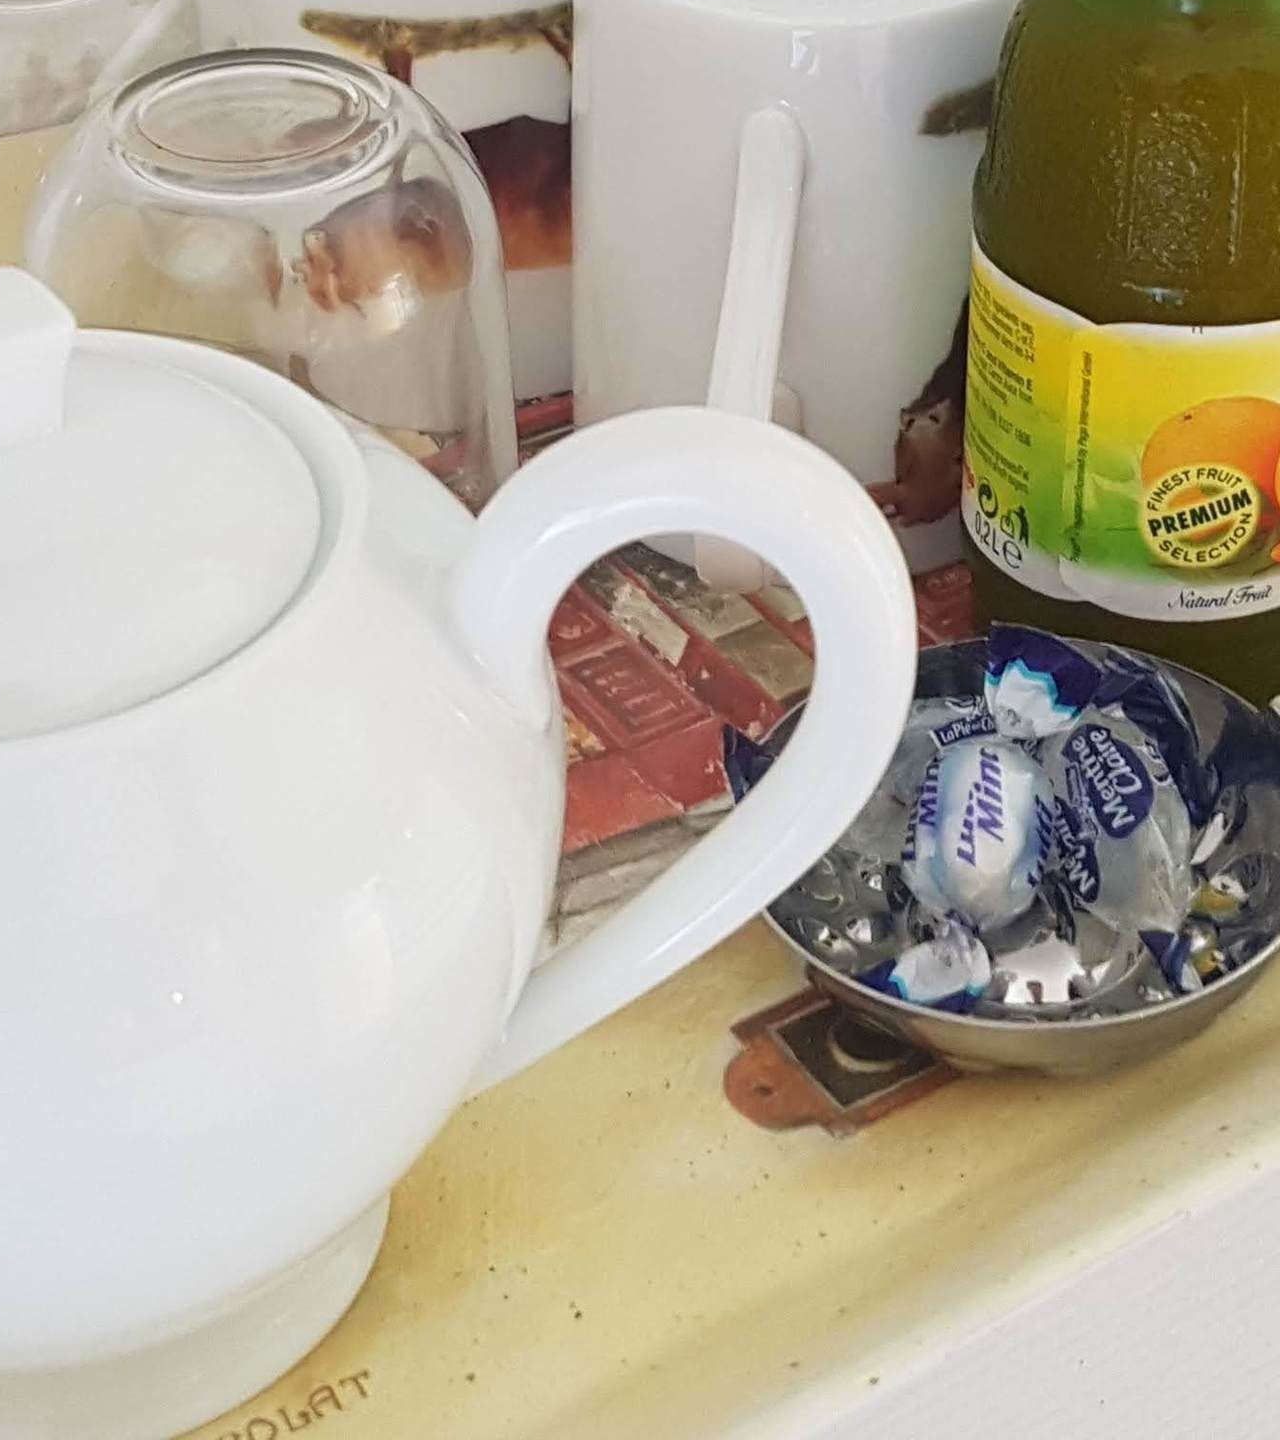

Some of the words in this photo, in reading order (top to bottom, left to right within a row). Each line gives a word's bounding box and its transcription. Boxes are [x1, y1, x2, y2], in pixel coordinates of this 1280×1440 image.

[1146, 469, 1192, 513] FINEST
[1196, 466, 1244, 490] FRUIT
[1147, 488, 1253, 538] PREMIUM
[1158, 511, 1254, 564] SELECTION
[1167, 588, 1232, 610] Natural
[1232, 584, 1273, 607] Fruit
[1071, 733, 1136, 830] Menthe
[1089, 727, 1143, 796] Claire
